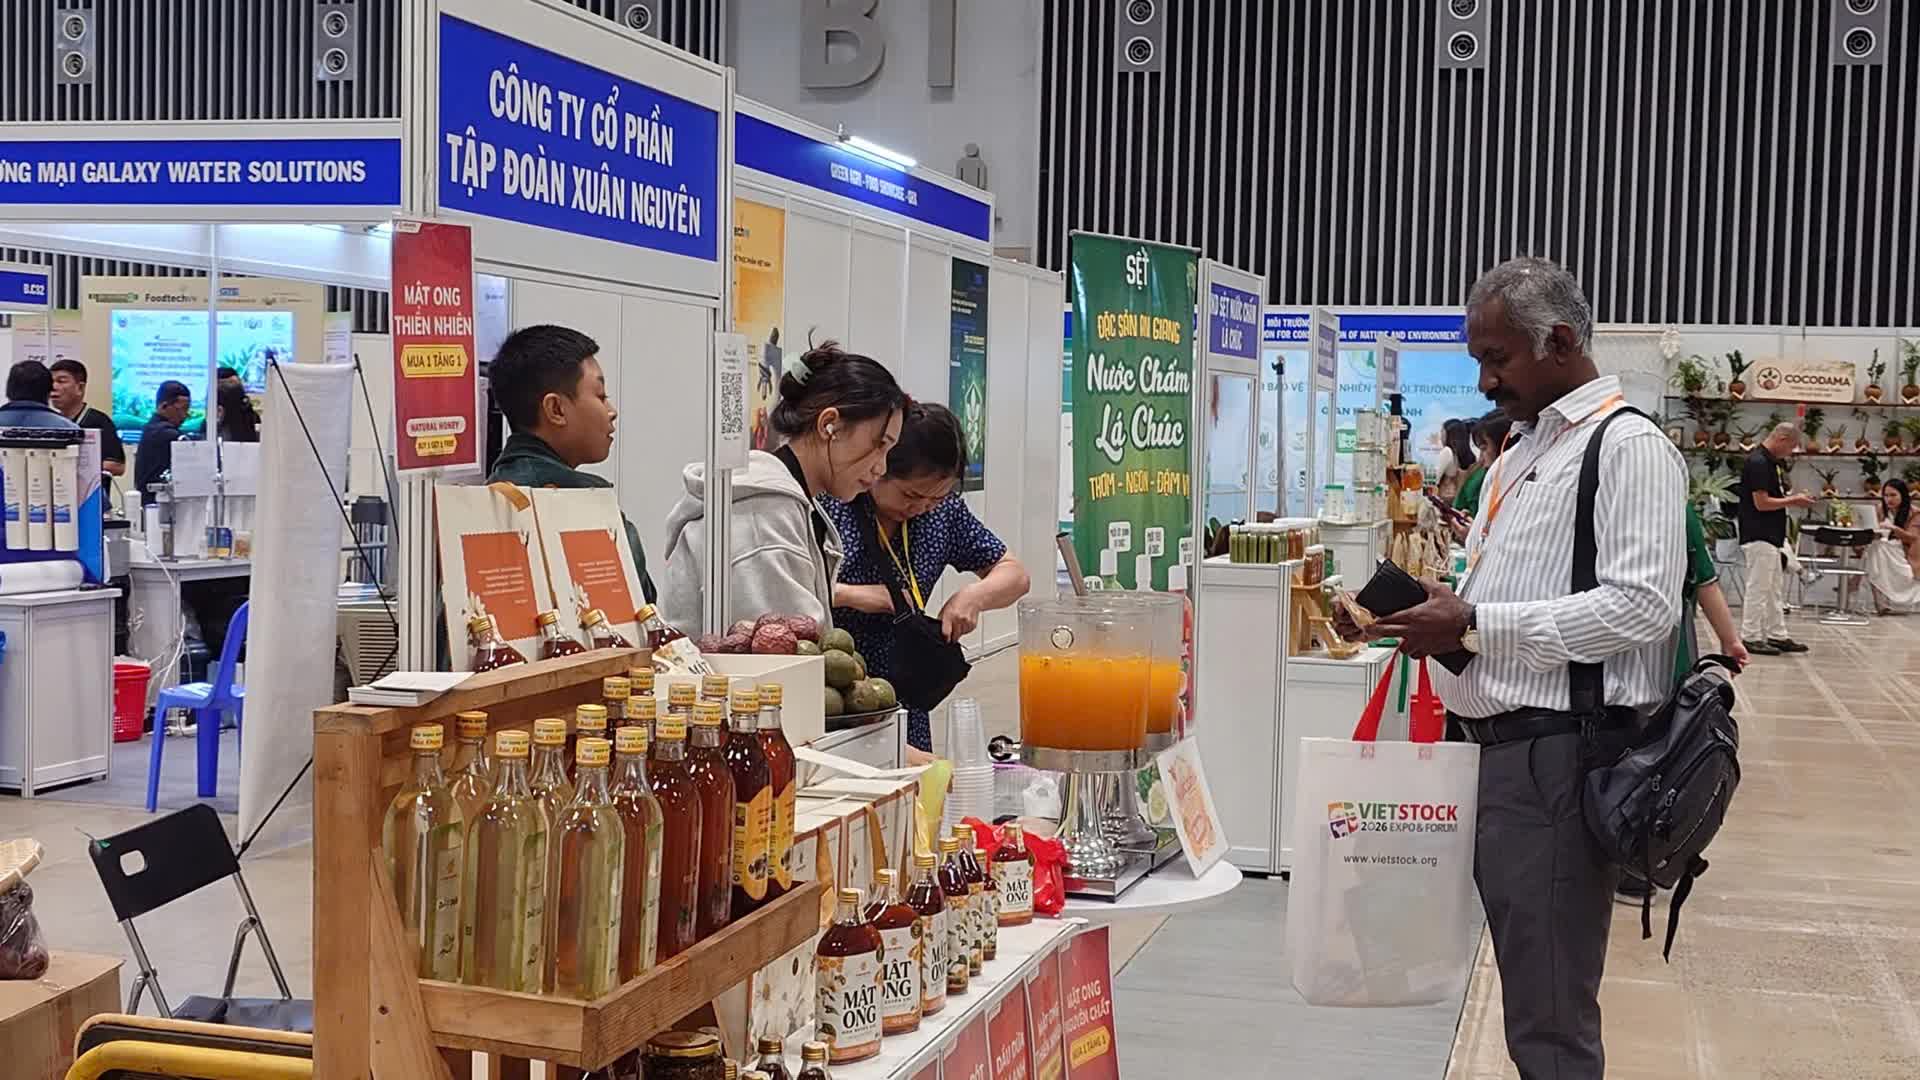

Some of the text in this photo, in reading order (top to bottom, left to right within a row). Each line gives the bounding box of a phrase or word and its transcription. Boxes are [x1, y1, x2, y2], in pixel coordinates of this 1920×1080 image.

[489, 62, 673, 167] CÔNG TY CỔ PHẦN
[38, 161, 76, 188] MẠI
[82, 161, 161, 183] GALAXY
[167, 161, 241, 183] WATER
[248, 160, 366, 183] SOLUTIONS
[446, 125, 700, 237] TẬP ĐOÀN XUÂN NGUYÊN
[404, 280, 461, 310] MẬT ONG
[434, 312, 472, 336] NHIÊN
[1097, 311, 1116, 342] ĐẶC
[1118, 309, 1137, 338] SẢN
[1152, 317, 1180, 345] GIANG
[1277, 331, 1291, 339] FOR
[1347, 331, 1358, 339] OF
[407, 355, 425, 368] MUA
[426, 354, 431, 367] 1
[457, 354, 462, 367] 1
[1088, 353, 1189, 393] Nước Chấm
[1784, 375, 1850, 387] COCODAMA
[439, 421, 459, 431] HONEY
[1095, 403, 1184, 462] Lá Chúc
[1089, 471, 1115, 501] THƠM
[1126, 470, 1149, 494] NGON
[1358, 803, 1458, 821] VIETSTOCK
[1361, 822, 1388, 832] 2026
[1425, 823, 1458, 832] FORUM
[1344, 854, 1438, 868] www.vietstock.org
[1007, 891, 1028, 903] ONG
[843, 984, 877, 1010] MẬT
[1081, 980, 1102, 1001] ONG
[843, 1005, 876, 1029] ONG
